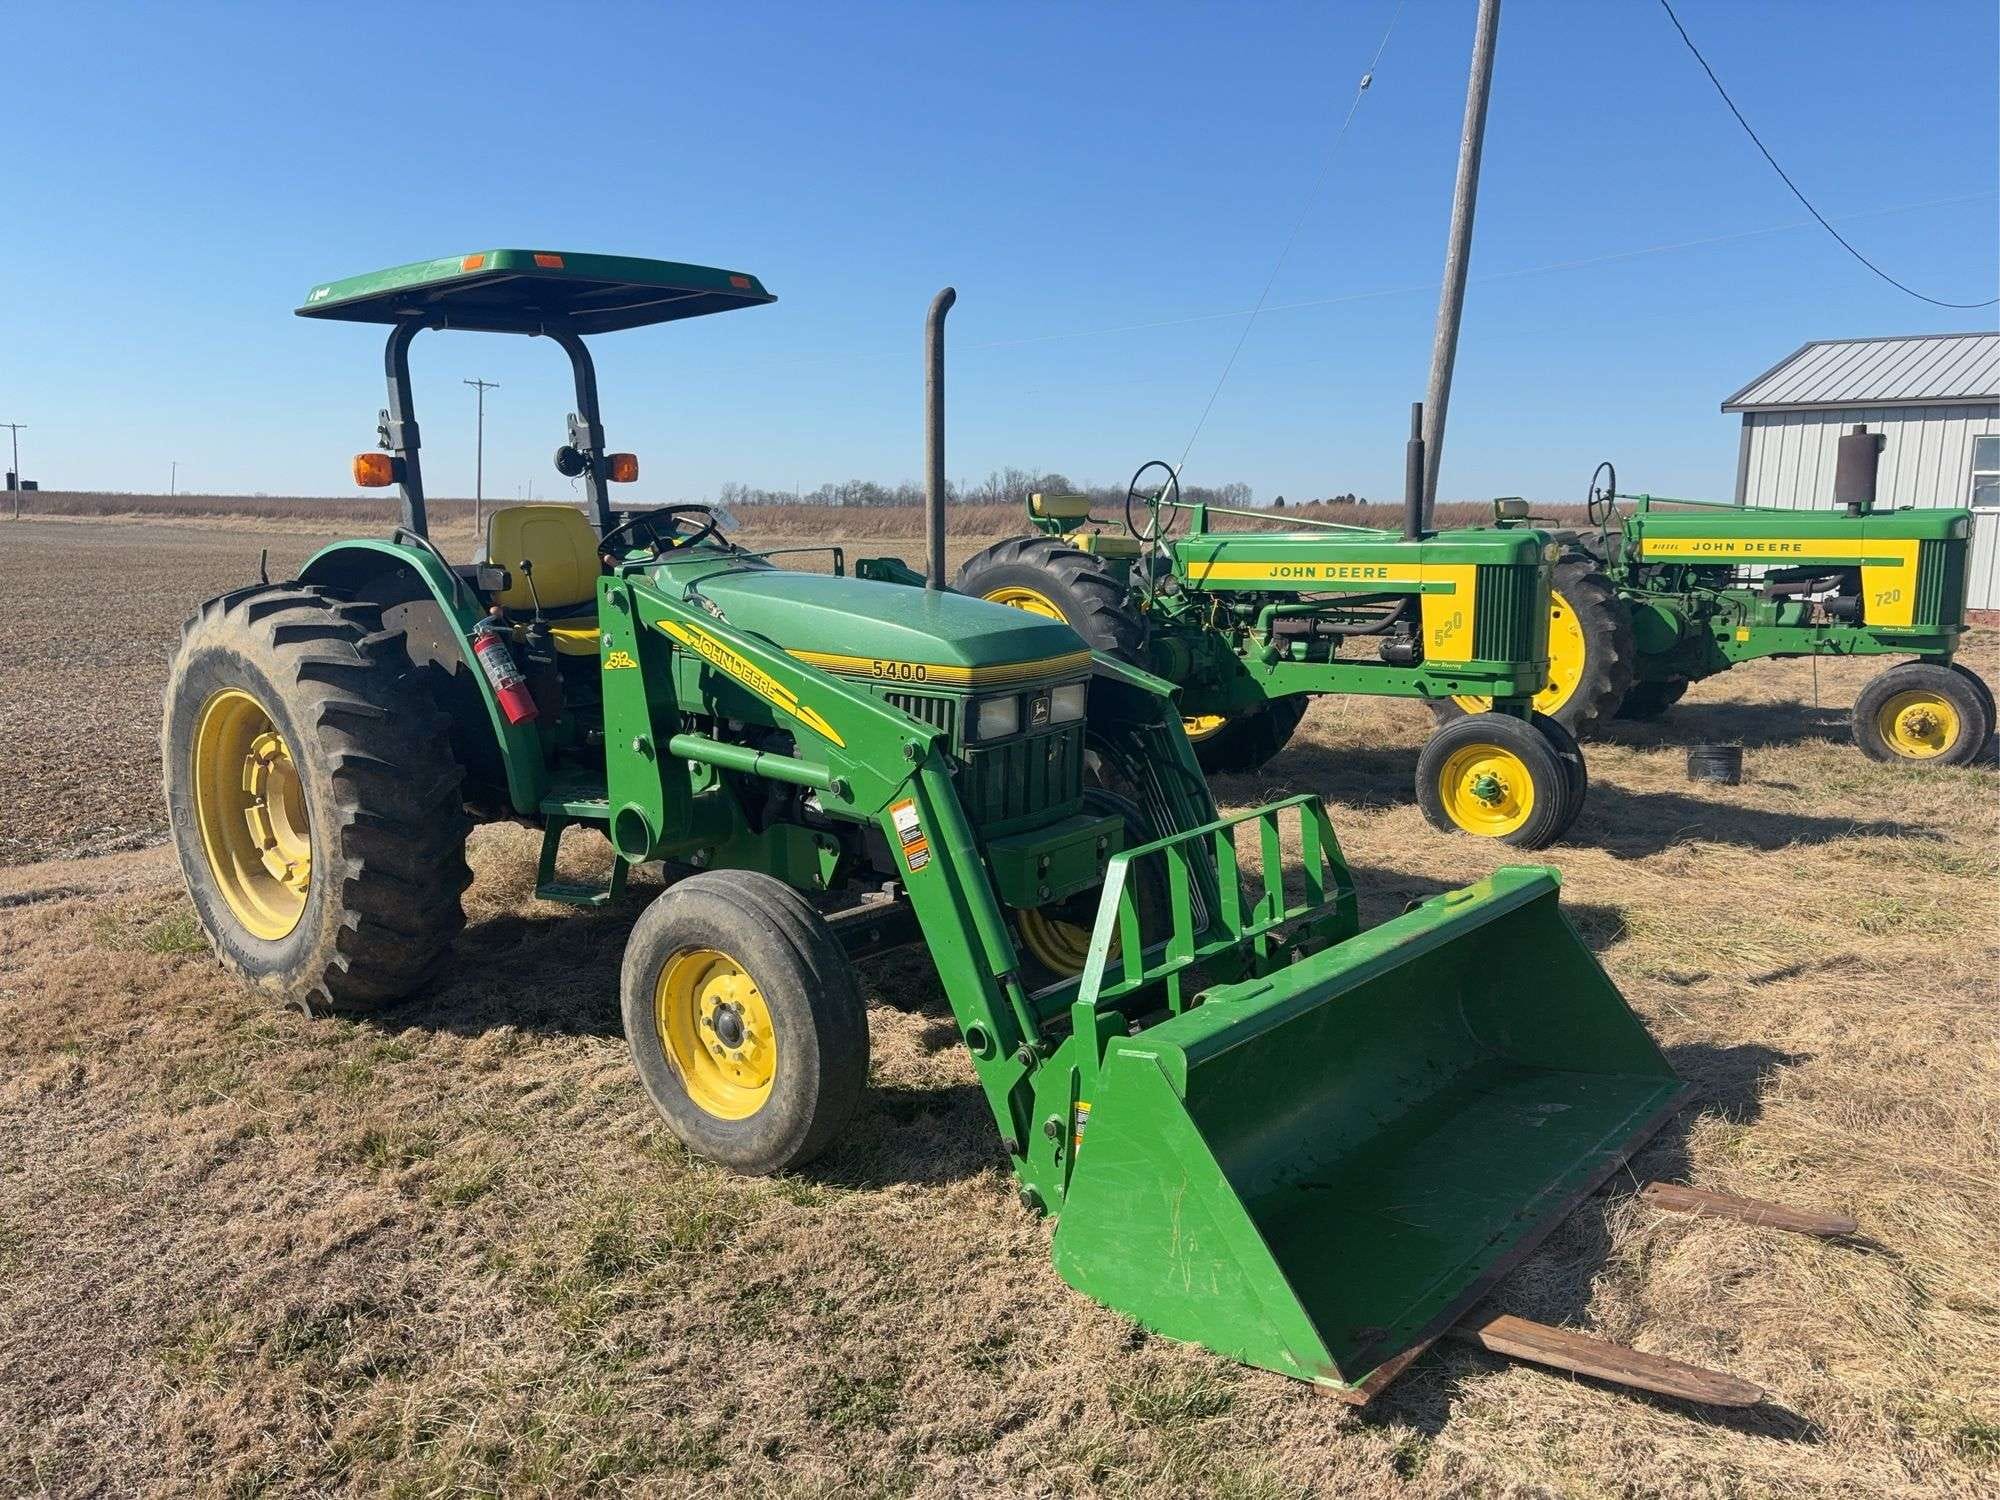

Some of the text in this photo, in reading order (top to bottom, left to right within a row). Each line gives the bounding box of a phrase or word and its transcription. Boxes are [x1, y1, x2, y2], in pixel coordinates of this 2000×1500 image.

[1692, 542, 1802, 552] JOHN DEERE
[1269, 566, 1389, 579] JOHN DEERE
[1875, 588, 1902, 607] 720
[1434, 610, 1463, 648] 520
[608, 650, 629, 668] 512
[692, 634, 777, 696] JOHN DEERE
[872, 660, 927, 682] 5400
